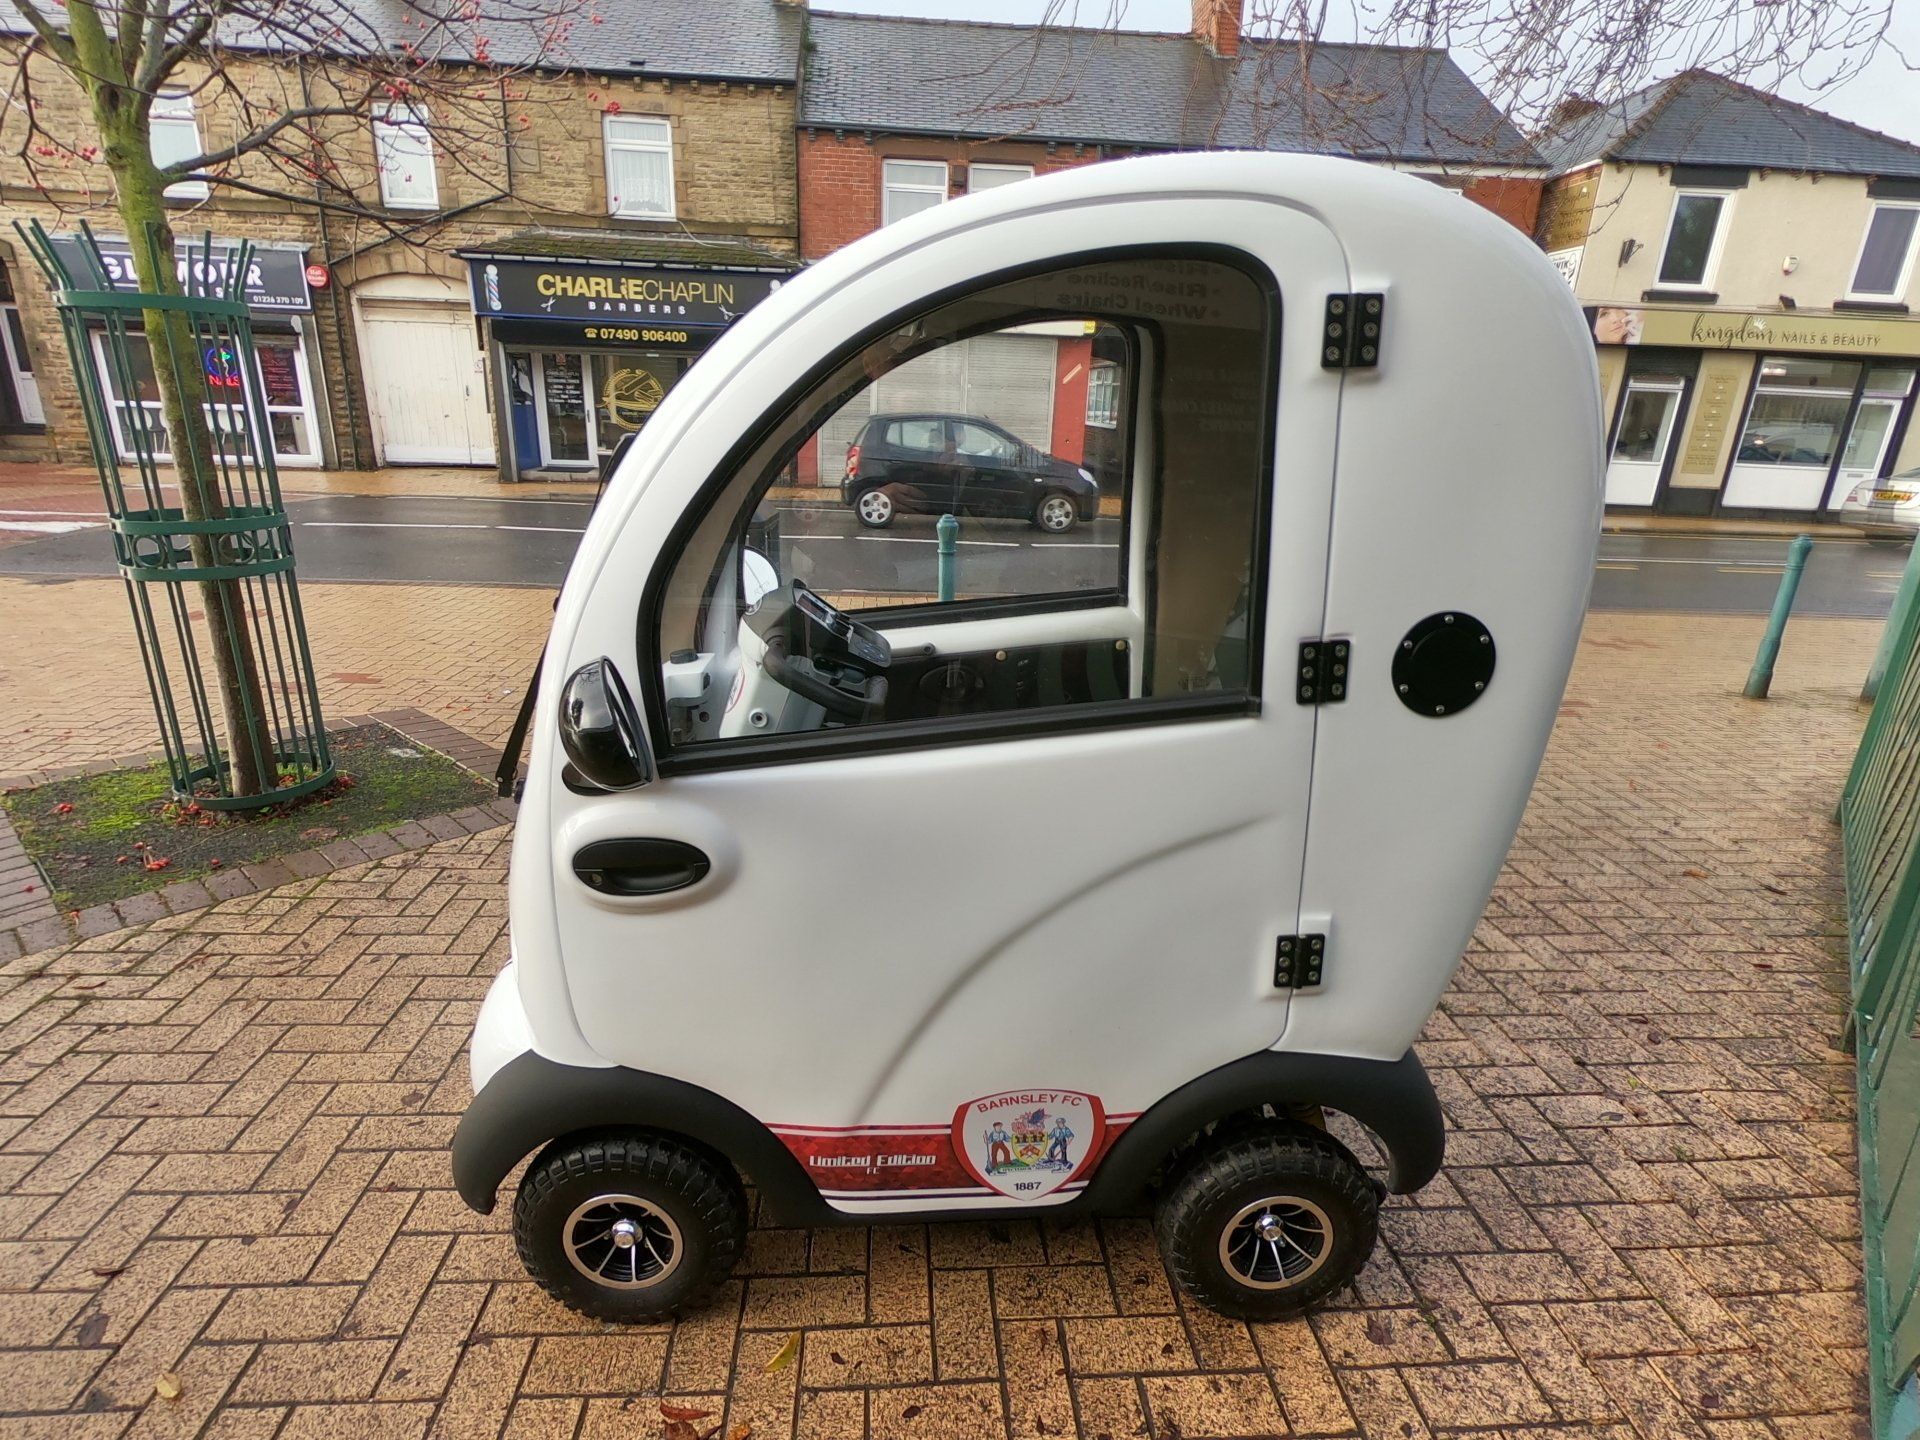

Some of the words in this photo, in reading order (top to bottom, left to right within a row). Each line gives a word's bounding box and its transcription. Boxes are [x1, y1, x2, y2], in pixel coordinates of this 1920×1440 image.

[588, 301, 686, 315] BARBERS
[600, 328, 639, 341] 07490
[642, 330, 688, 343] 906400
[1781, 331, 1817, 345] NAILS
[1820, 333, 1828, 345] &
[1832, 333, 1881, 347] BEAUTY
[977, 1093, 1059, 1113] BARNSLEY
[1061, 1094, 1082, 1107] FC
[809, 1154, 871, 1168] Limited
[876, 1153, 937, 1167] Edition
[866, 1166, 880, 1175] FC
[1014, 1181, 1042, 1191] 1887
